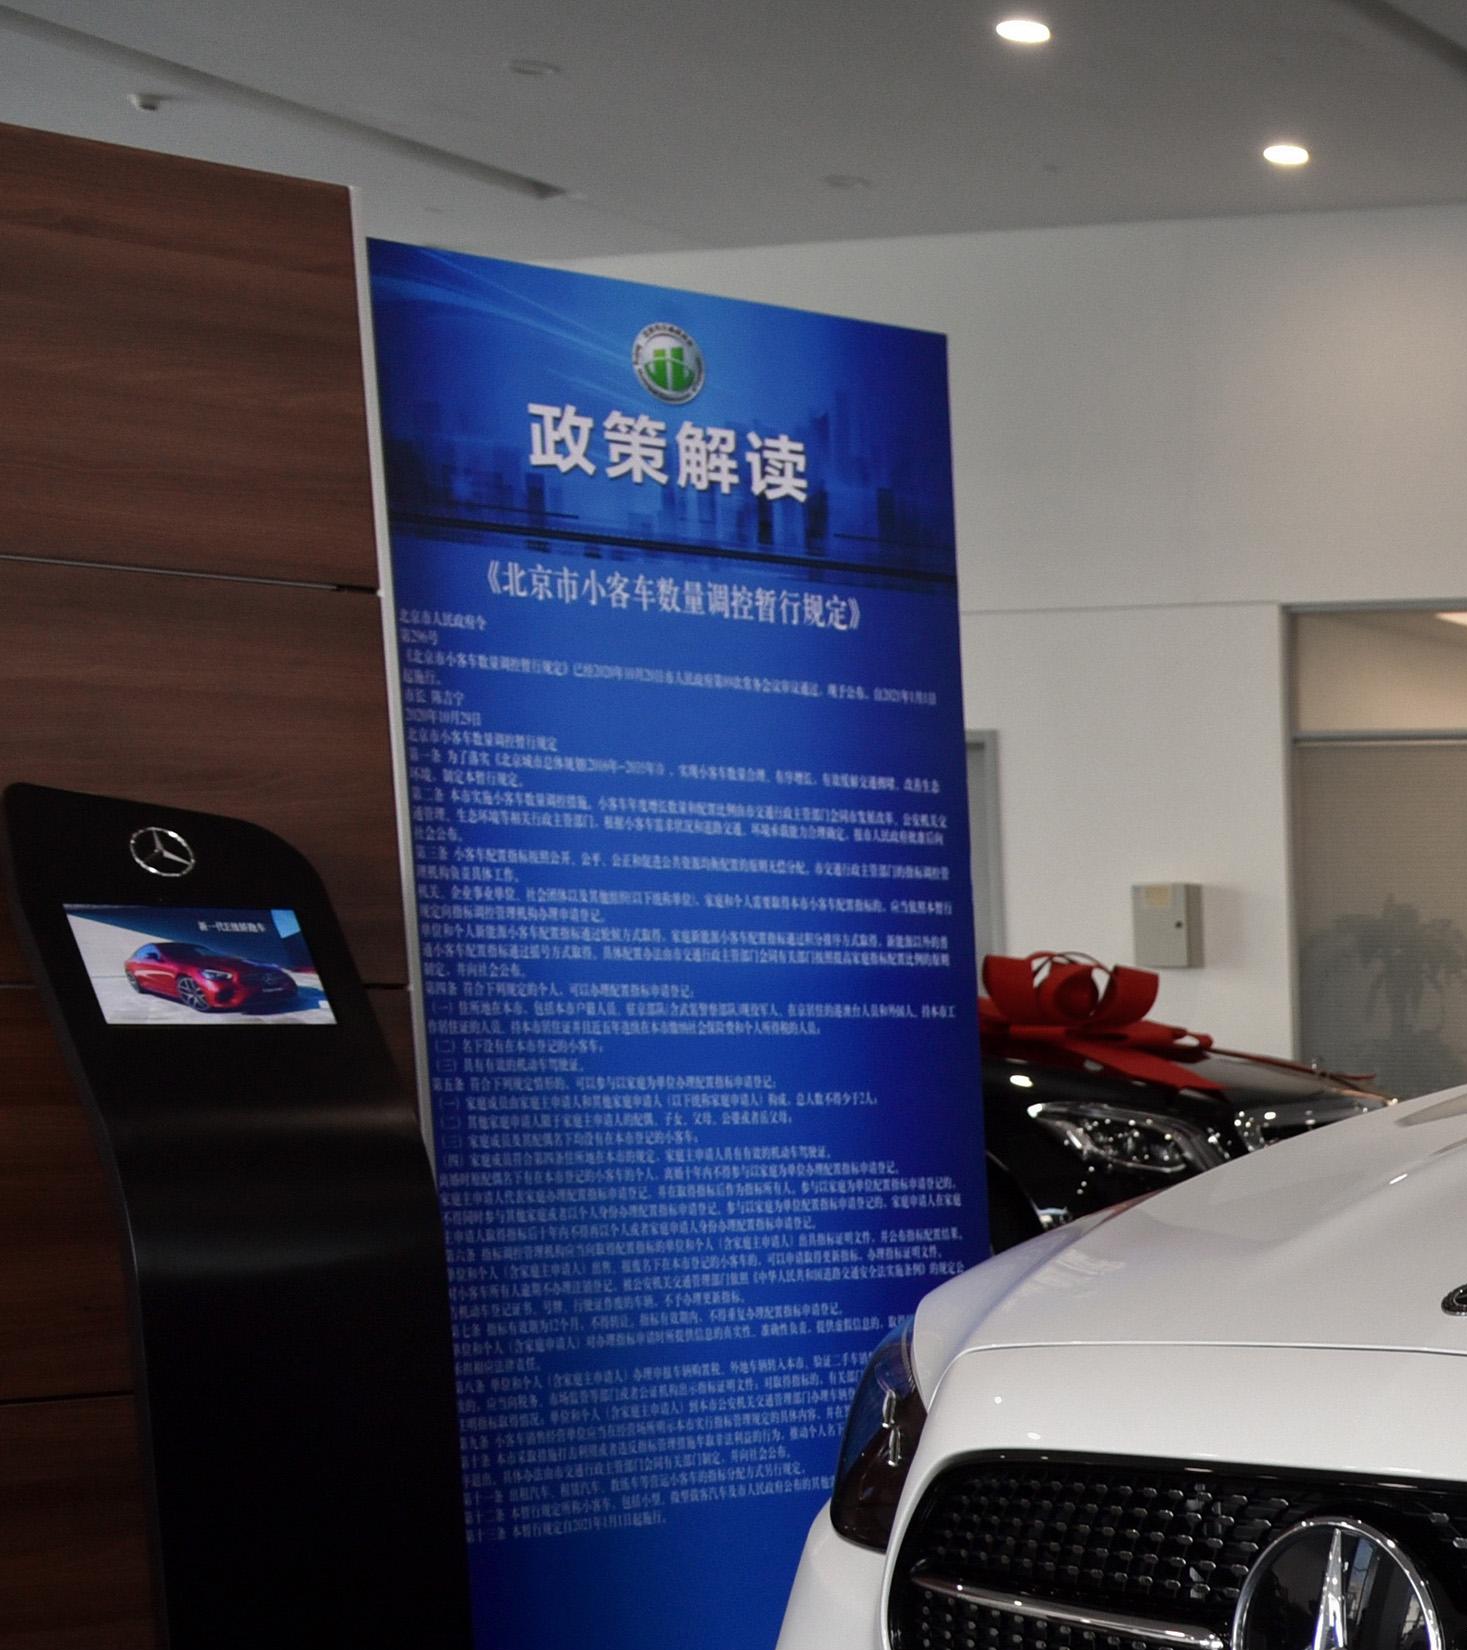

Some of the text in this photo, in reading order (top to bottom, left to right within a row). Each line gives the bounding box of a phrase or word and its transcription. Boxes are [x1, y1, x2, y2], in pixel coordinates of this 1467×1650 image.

[526, 402, 809, 503] 政策解读
[487, 559, 862, 631] 《北京市小客车数量调控暂行规定》
